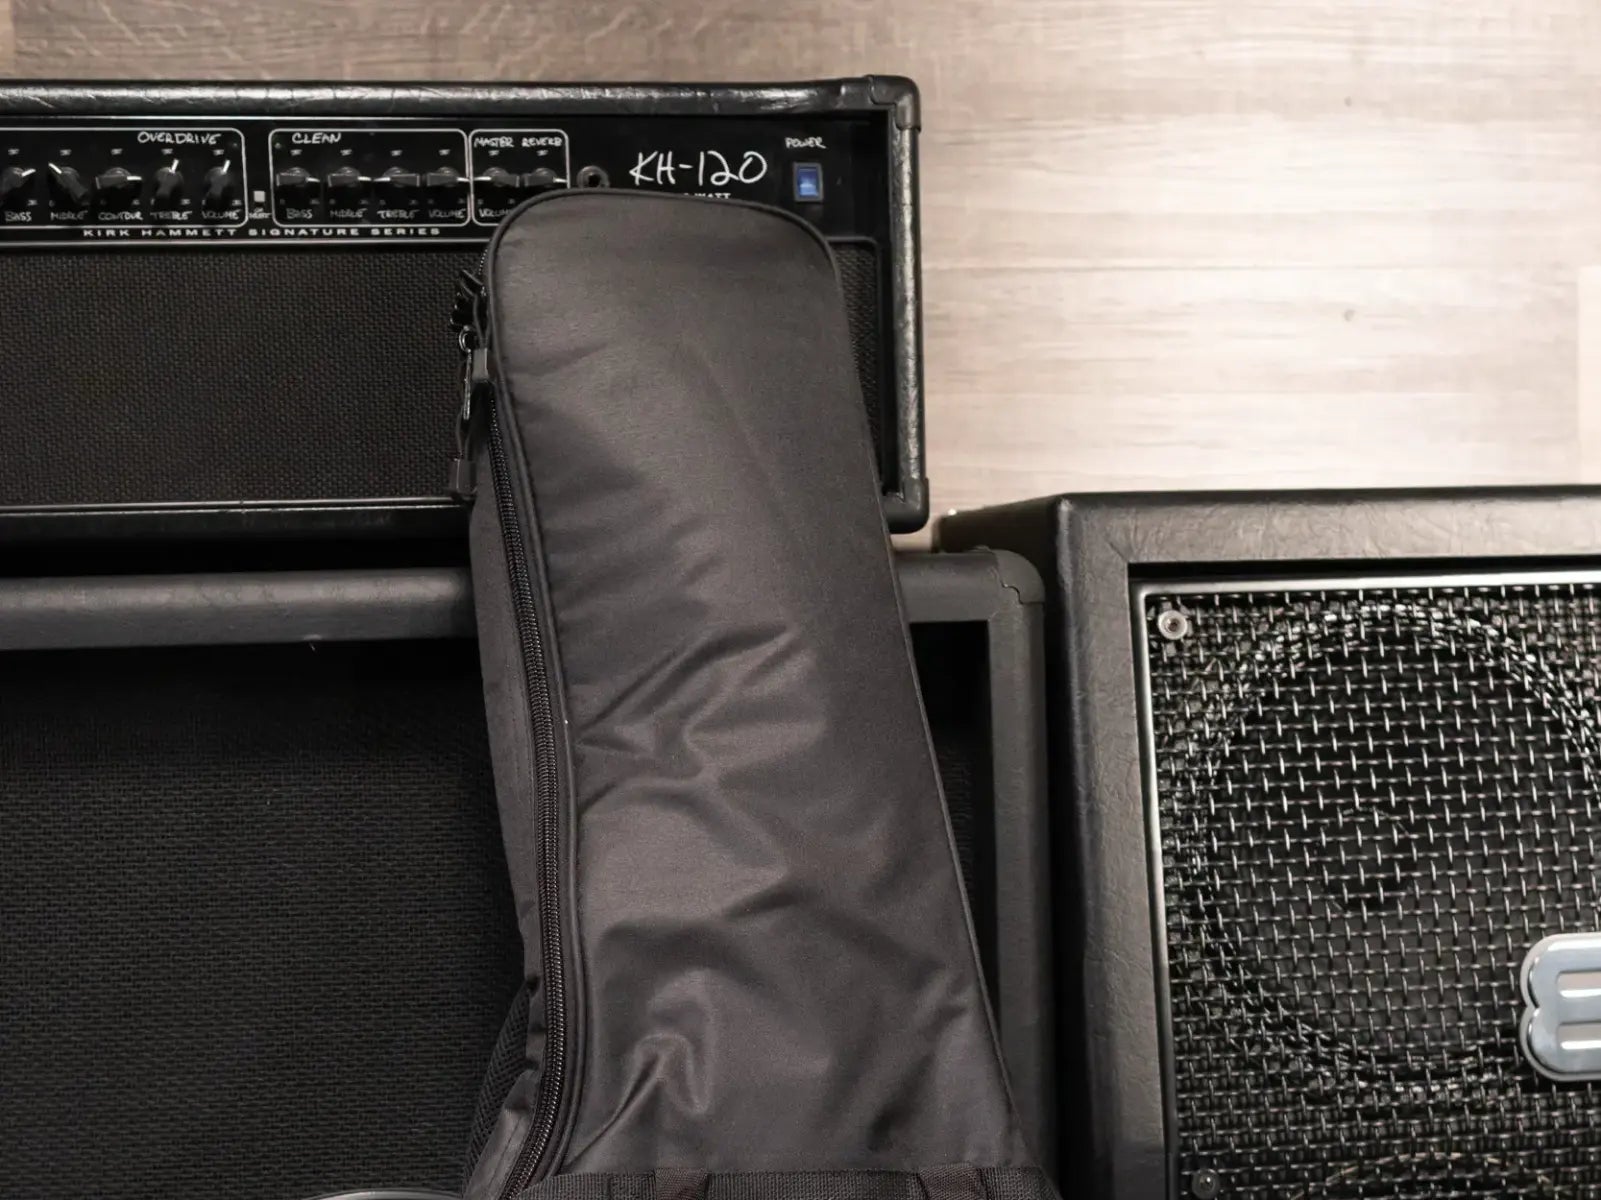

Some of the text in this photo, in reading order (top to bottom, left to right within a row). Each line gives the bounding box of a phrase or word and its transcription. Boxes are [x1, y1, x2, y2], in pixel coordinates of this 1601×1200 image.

[136, 131, 222, 146] OVERDRIVE
[291, 131, 342, 145] CLEAN
[474, 136, 515, 149] MASTER
[521, 136, 562, 149] REVERB
[784, 136, 827, 150] POWER
[628, 150, 768, 187] KH-120
[4, 210, 32, 223] BASS
[82, 227, 441, 238] KIRK HAMMETT SIGNATURE SERIES
